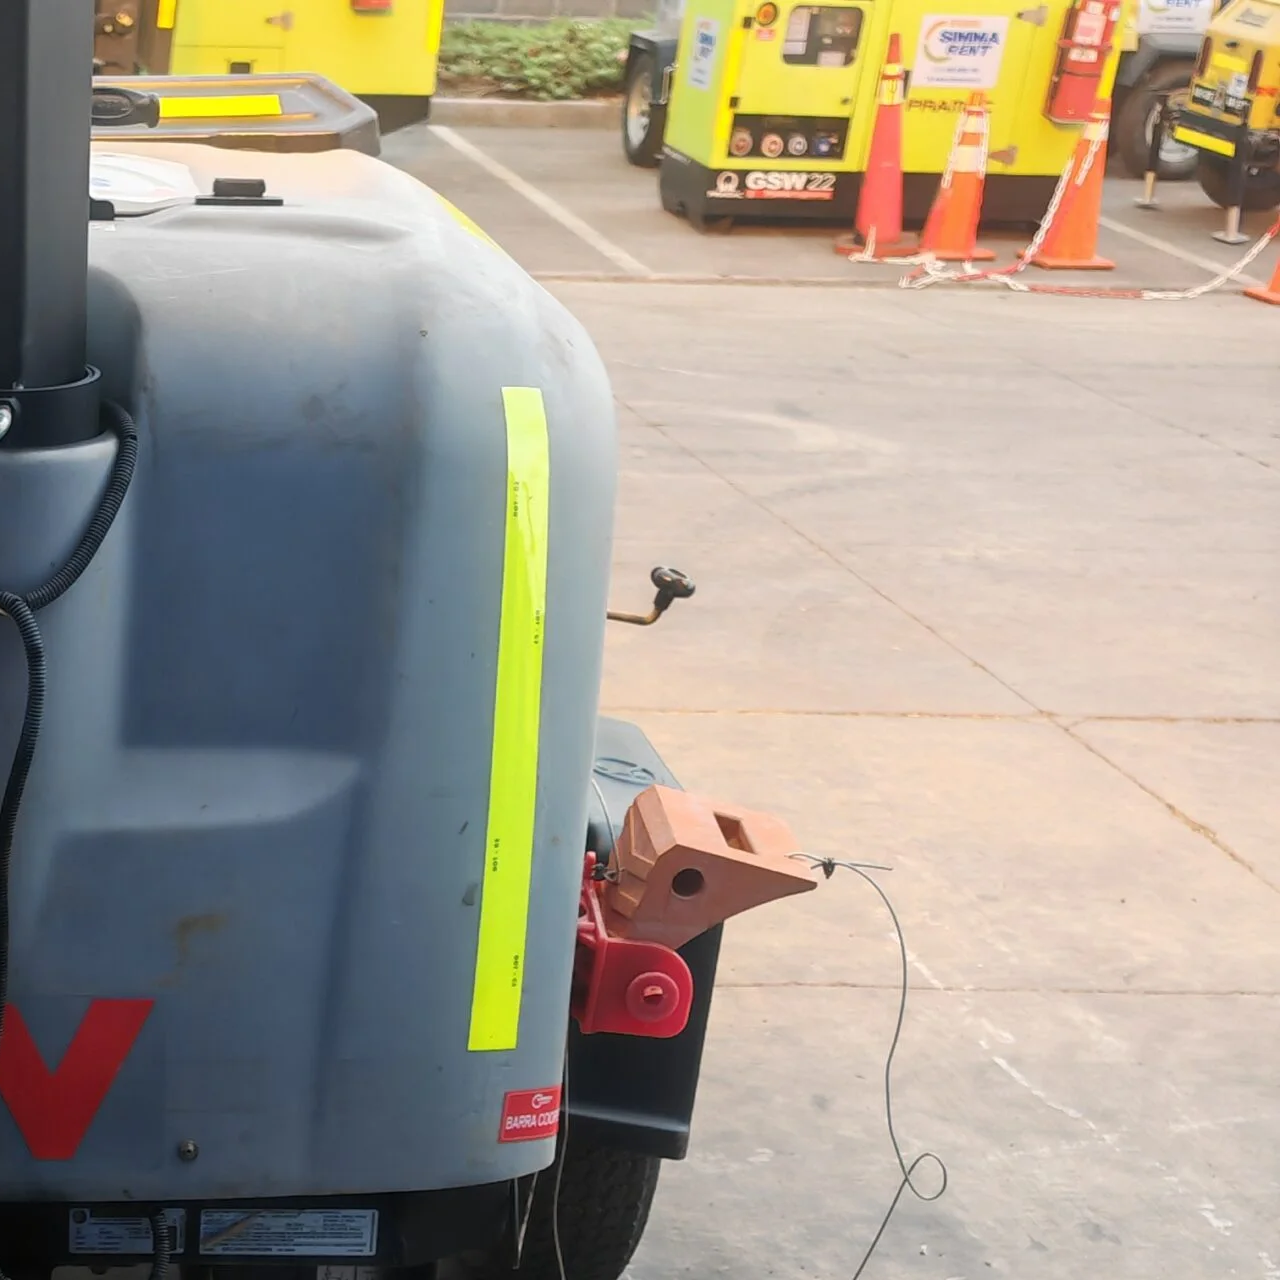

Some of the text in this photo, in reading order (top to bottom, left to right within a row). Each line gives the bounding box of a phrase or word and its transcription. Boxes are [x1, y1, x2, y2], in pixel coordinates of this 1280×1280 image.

[940, 31, 999, 45] SIMMA
[946, 45, 992, 56] RENT
[505, 1114, 537, 1130] BARRA
